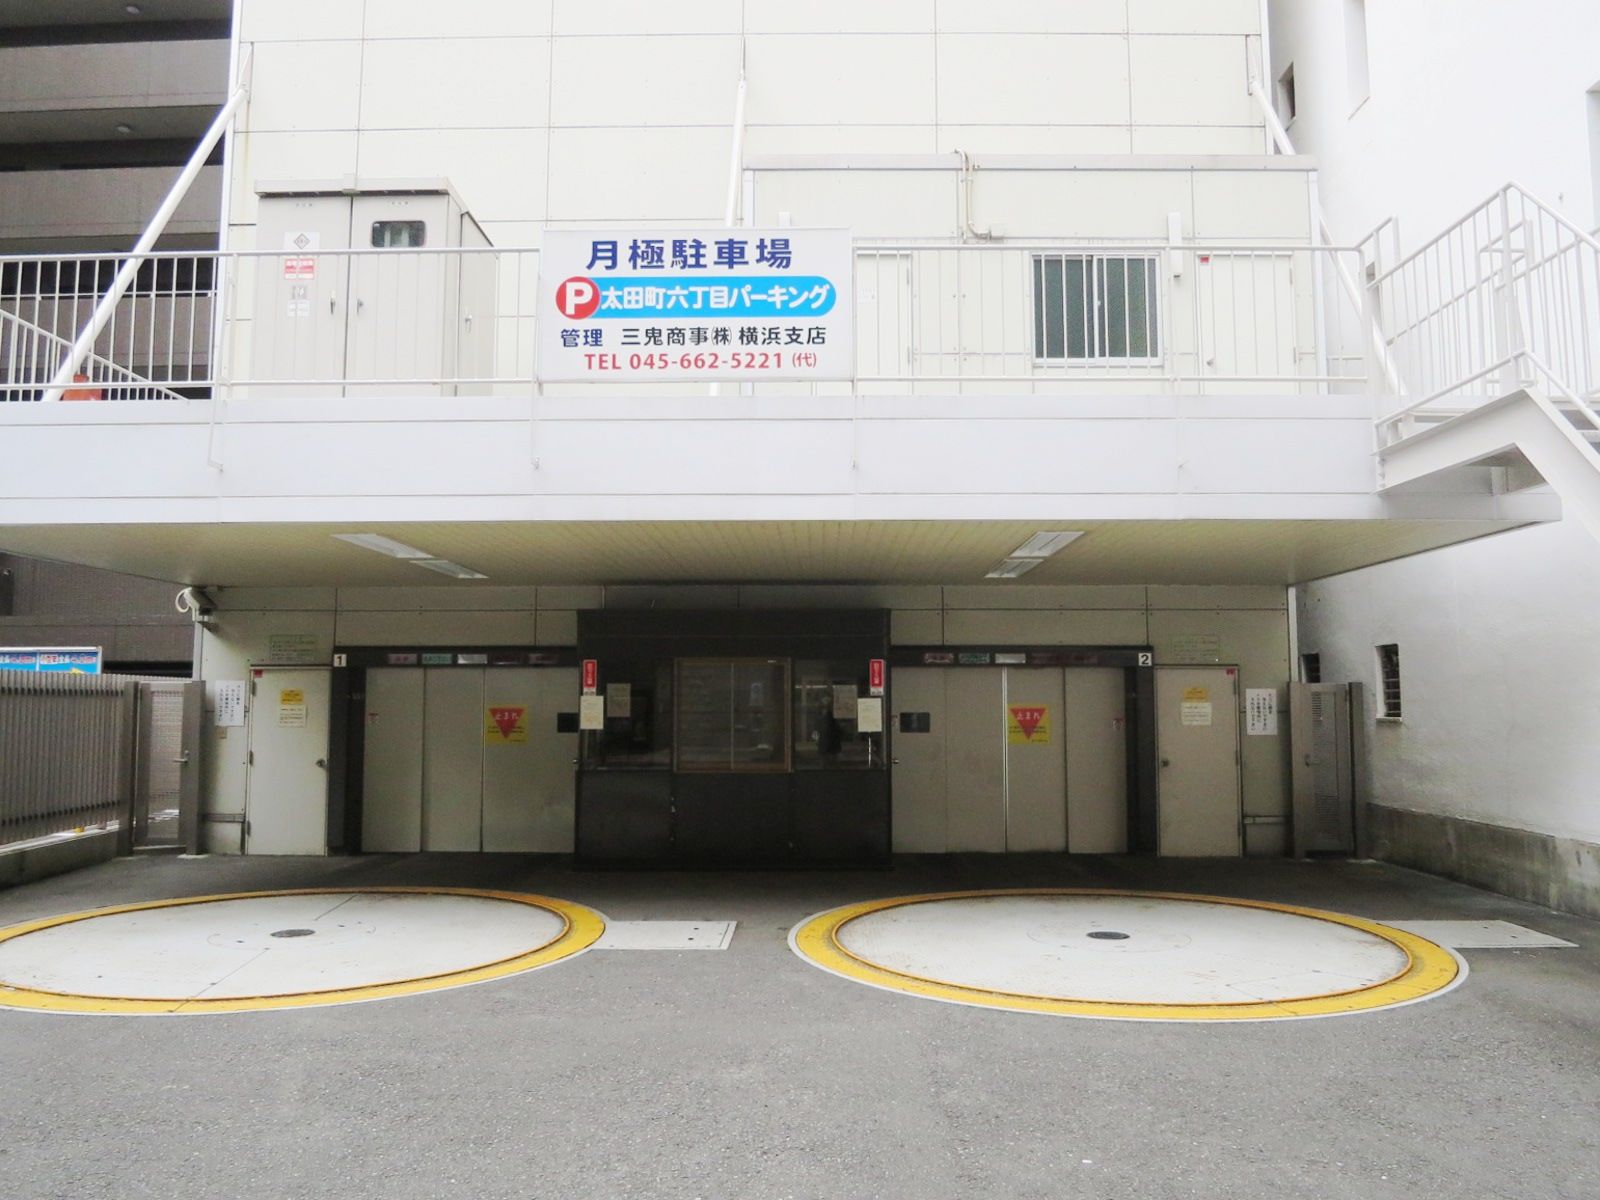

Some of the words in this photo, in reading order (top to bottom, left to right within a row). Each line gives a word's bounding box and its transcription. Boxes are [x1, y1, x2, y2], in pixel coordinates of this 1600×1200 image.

[586, 238, 793, 270] 月極駐車場
[565, 282, 593, 316] P
[601, 283, 830, 310] 太田町六丁目パーキング
[560, 328, 604, 348] 管理
[584, 353, 622, 370] TEL
[629, 352, 783, 370] 045-662-5221
[1140, 653, 1149, 665] 2
